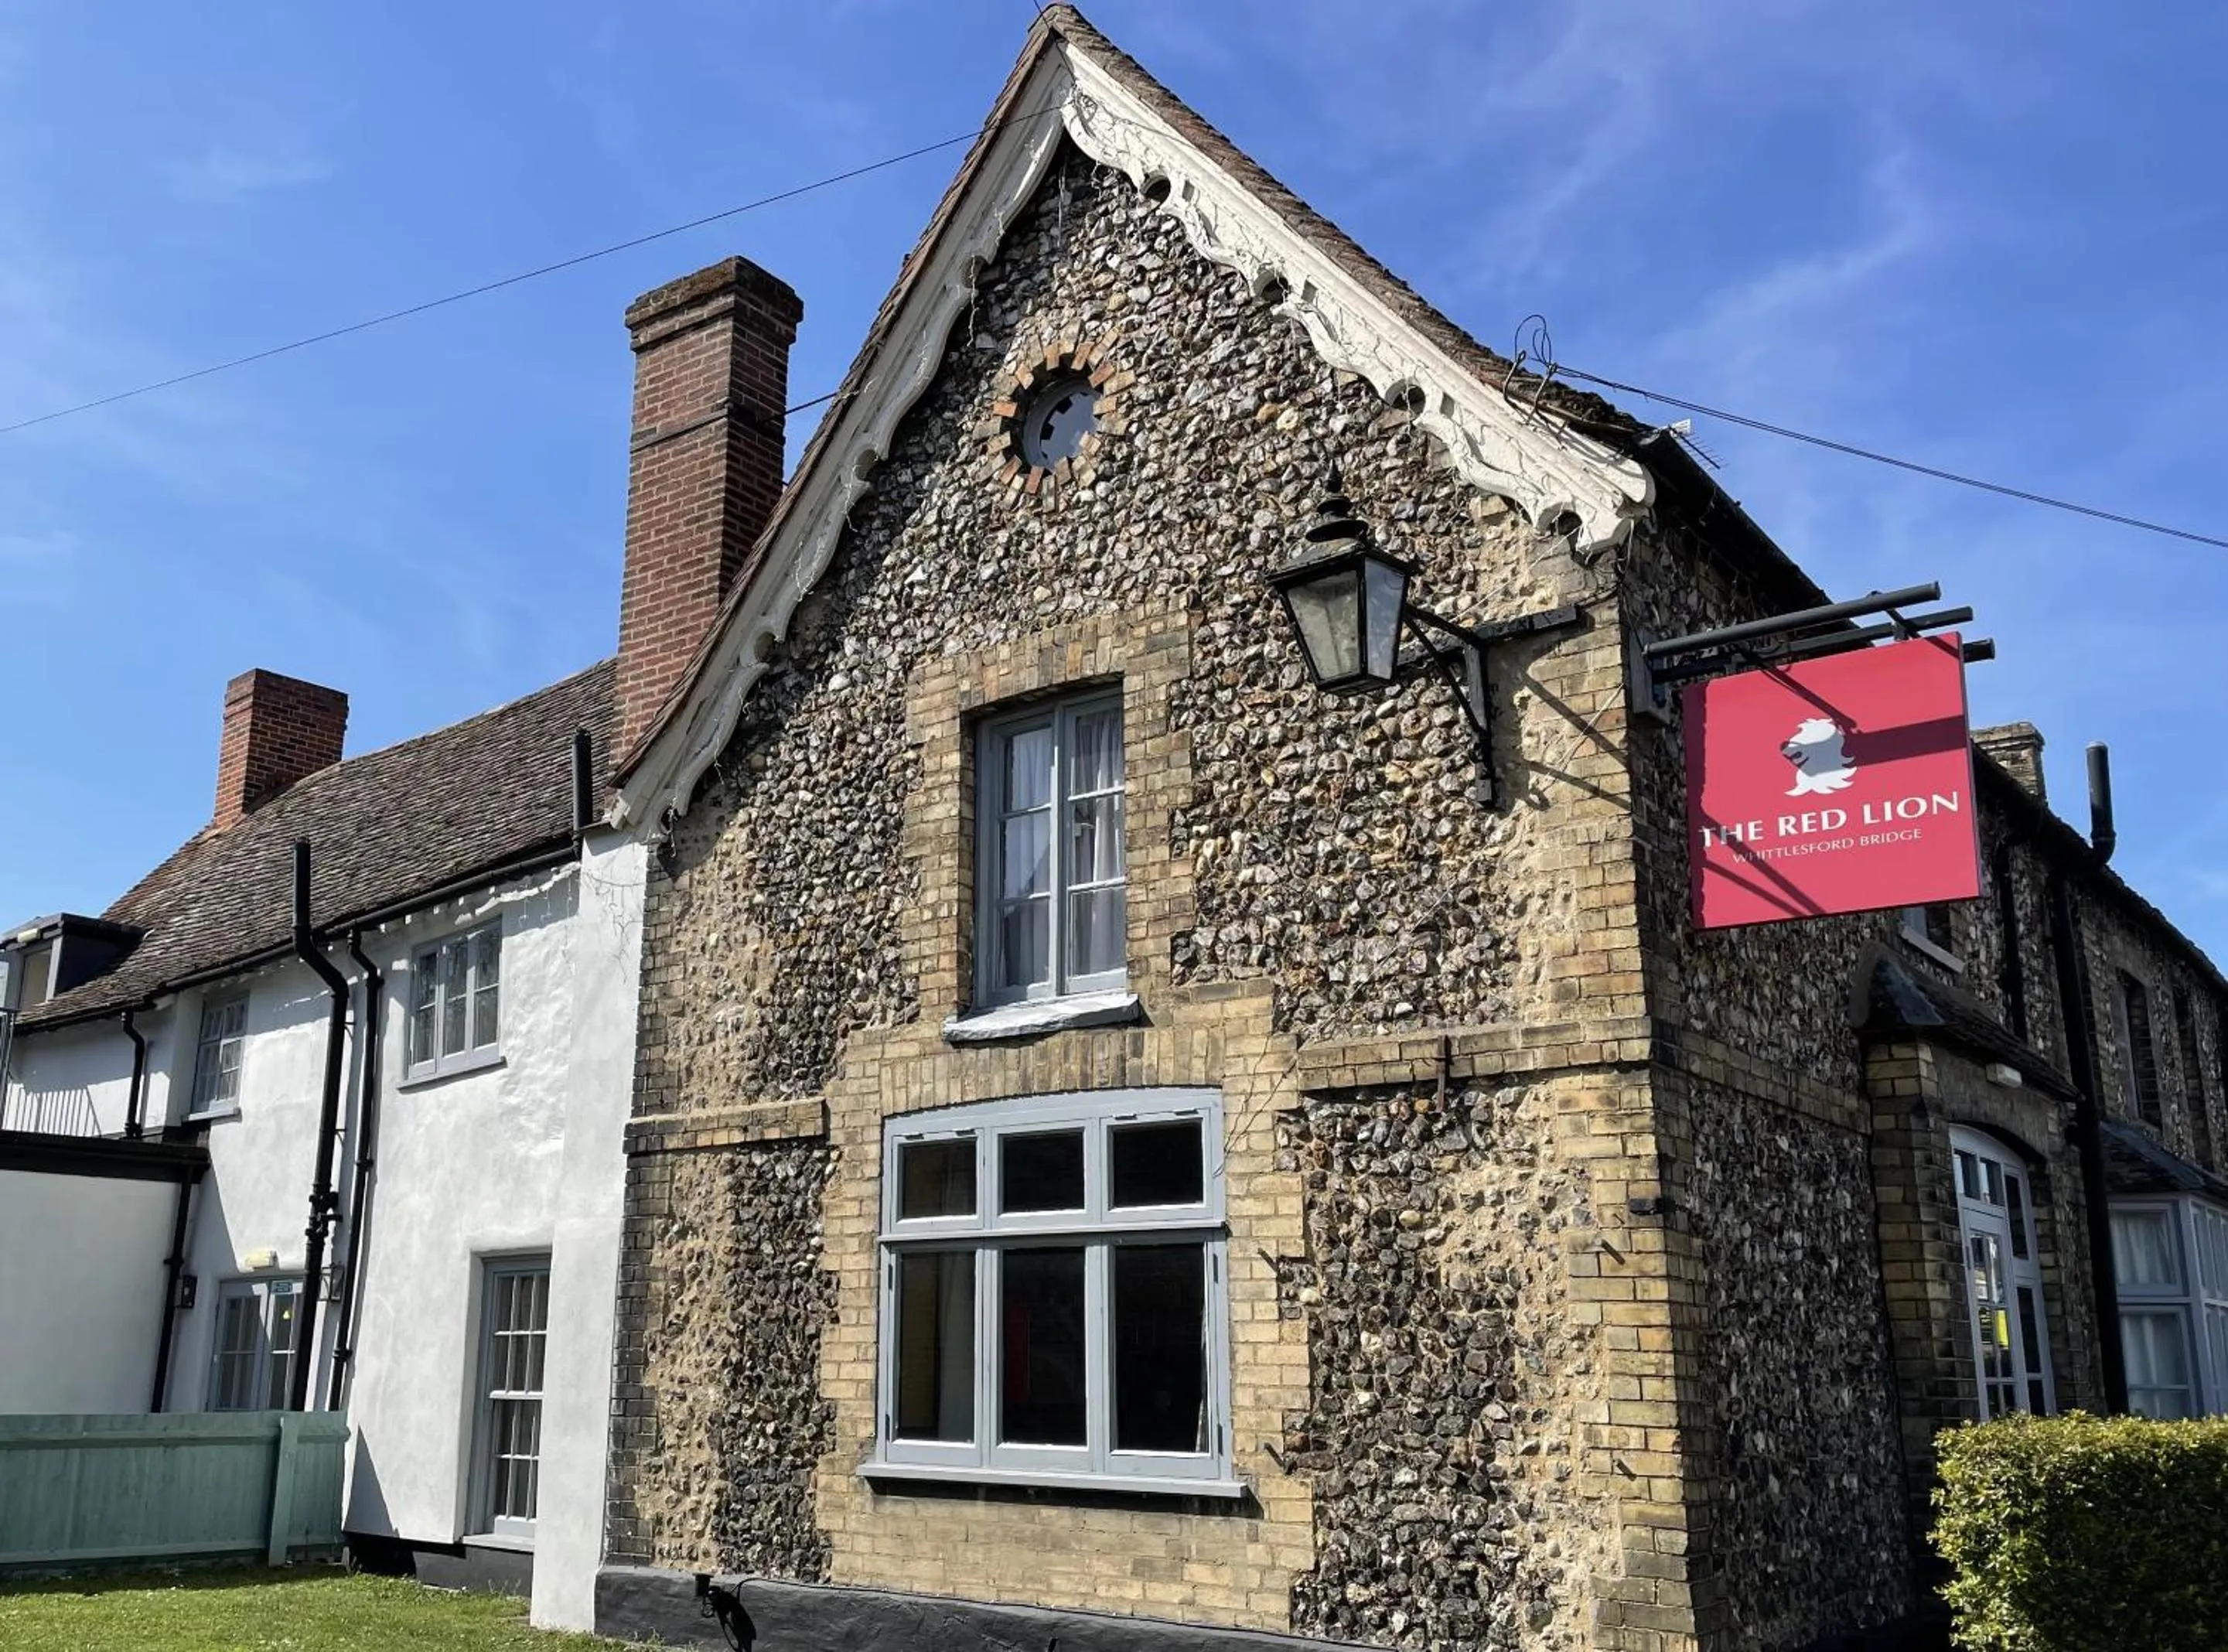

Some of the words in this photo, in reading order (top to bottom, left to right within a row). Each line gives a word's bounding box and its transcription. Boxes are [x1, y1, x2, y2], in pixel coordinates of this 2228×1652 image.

[1699, 821, 1764, 848] THE
[1778, 809, 1848, 837] RED
[1863, 791, 1959, 825] LION
[1733, 838, 1854, 864] WHITTLESFORD
[1860, 828, 1923, 848] BRIDGE
